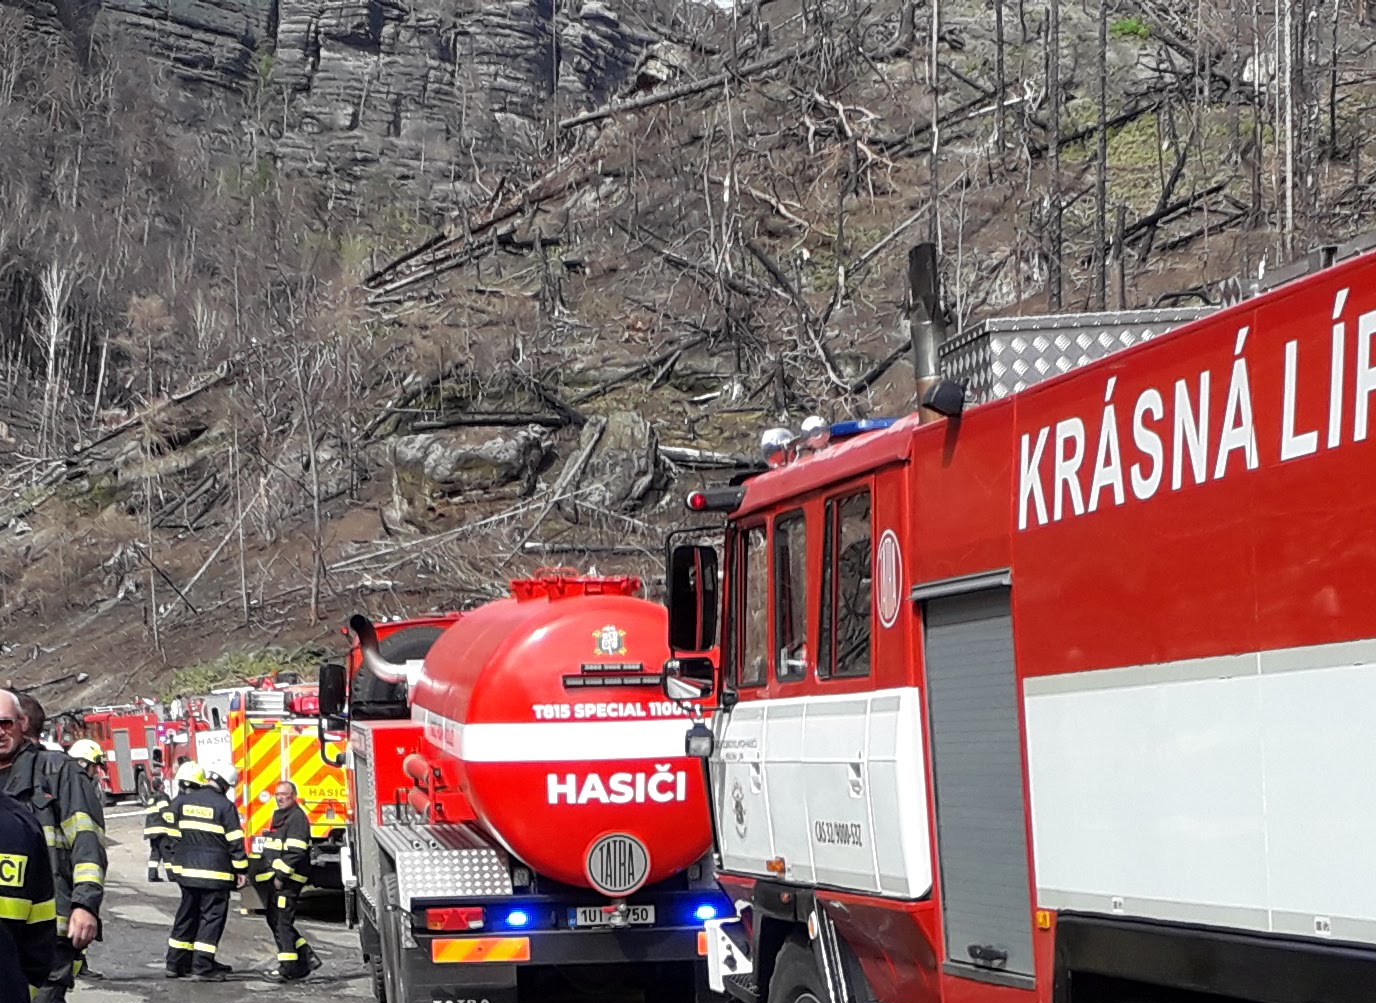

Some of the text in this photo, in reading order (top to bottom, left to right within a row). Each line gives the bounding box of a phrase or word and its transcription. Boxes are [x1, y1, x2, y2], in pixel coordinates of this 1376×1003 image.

[1018, 329, 1260, 531] KRÁSNÁ
[532, 704, 571, 719] T815
[574, 702, 646, 718] SPECIAL
[546, 763, 687, 805] HASIČI
[598, 839, 636, 889] TATRA
